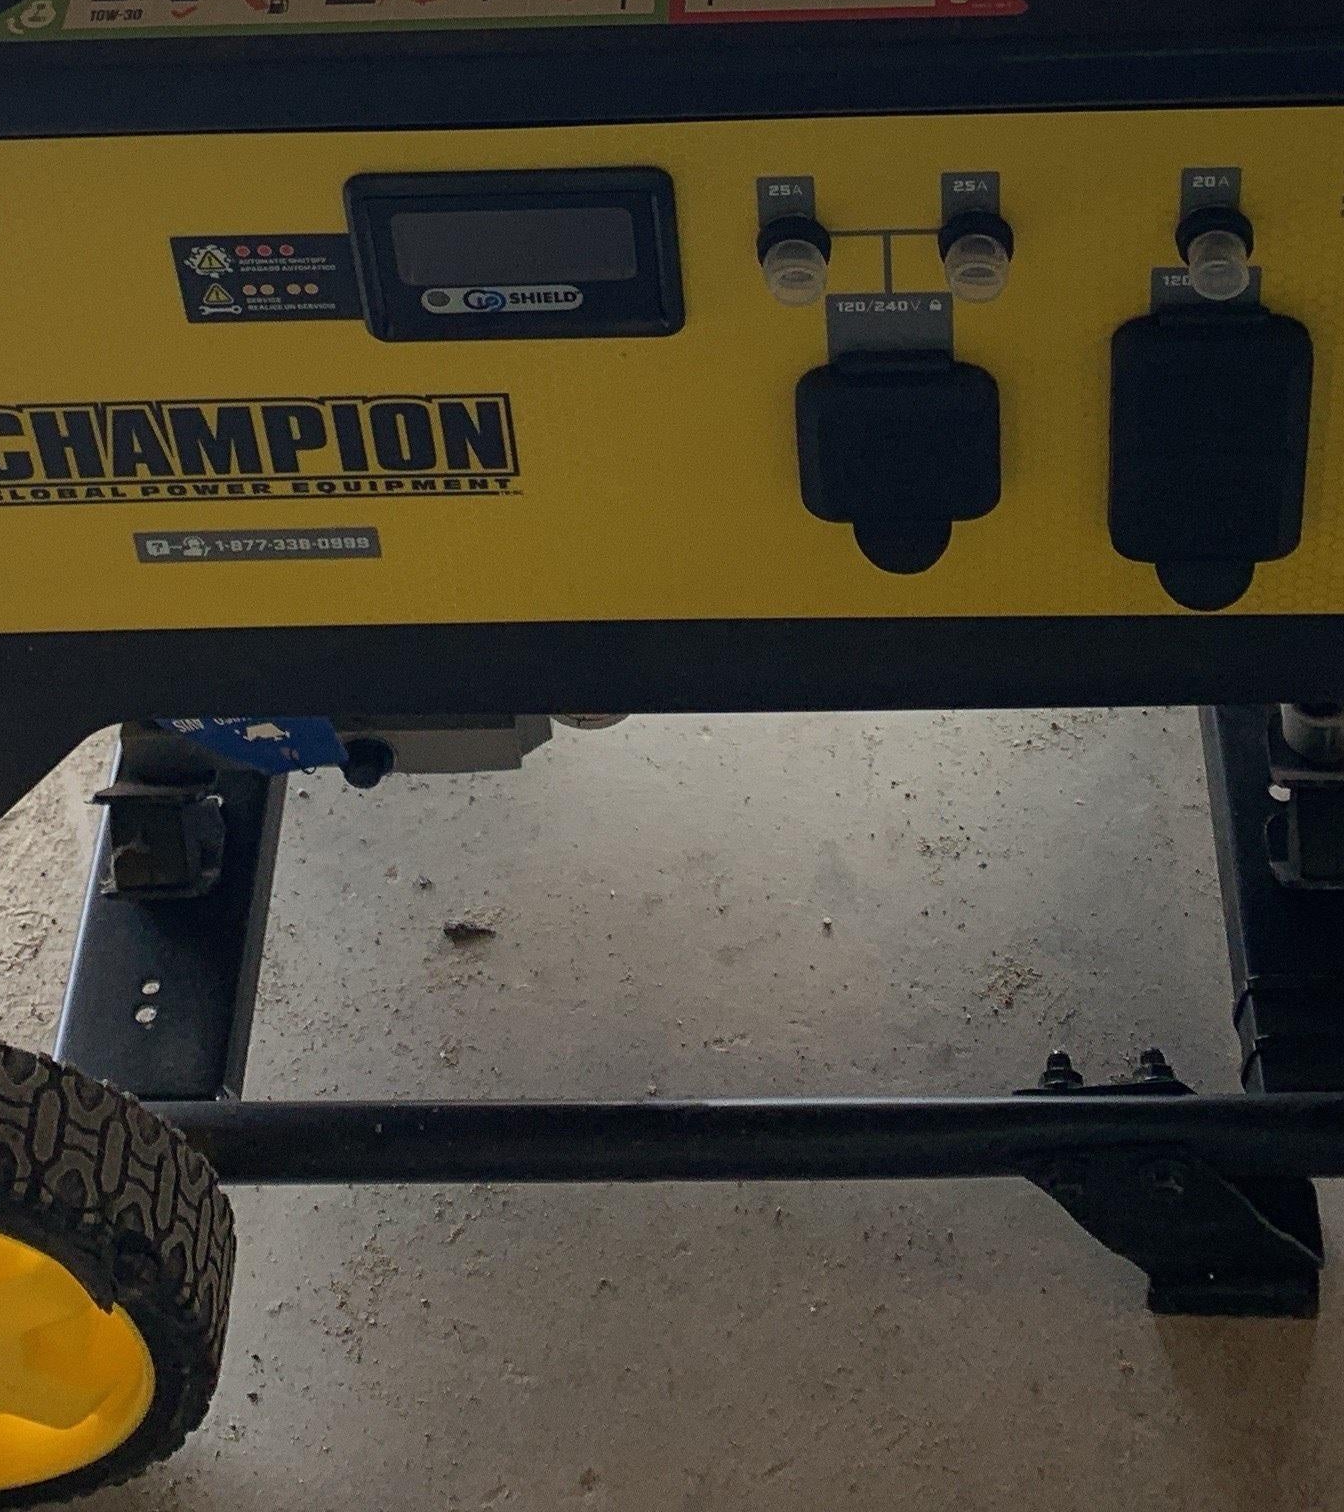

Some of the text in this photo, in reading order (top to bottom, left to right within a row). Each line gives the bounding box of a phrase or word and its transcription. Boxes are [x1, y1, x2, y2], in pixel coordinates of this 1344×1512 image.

[89, 7, 144, 22] 10W-30
[509, 291, 578, 304] SHIELD
[141, 482, 271, 497] POWER
[291, 478, 512, 495] EQUIPMENT
